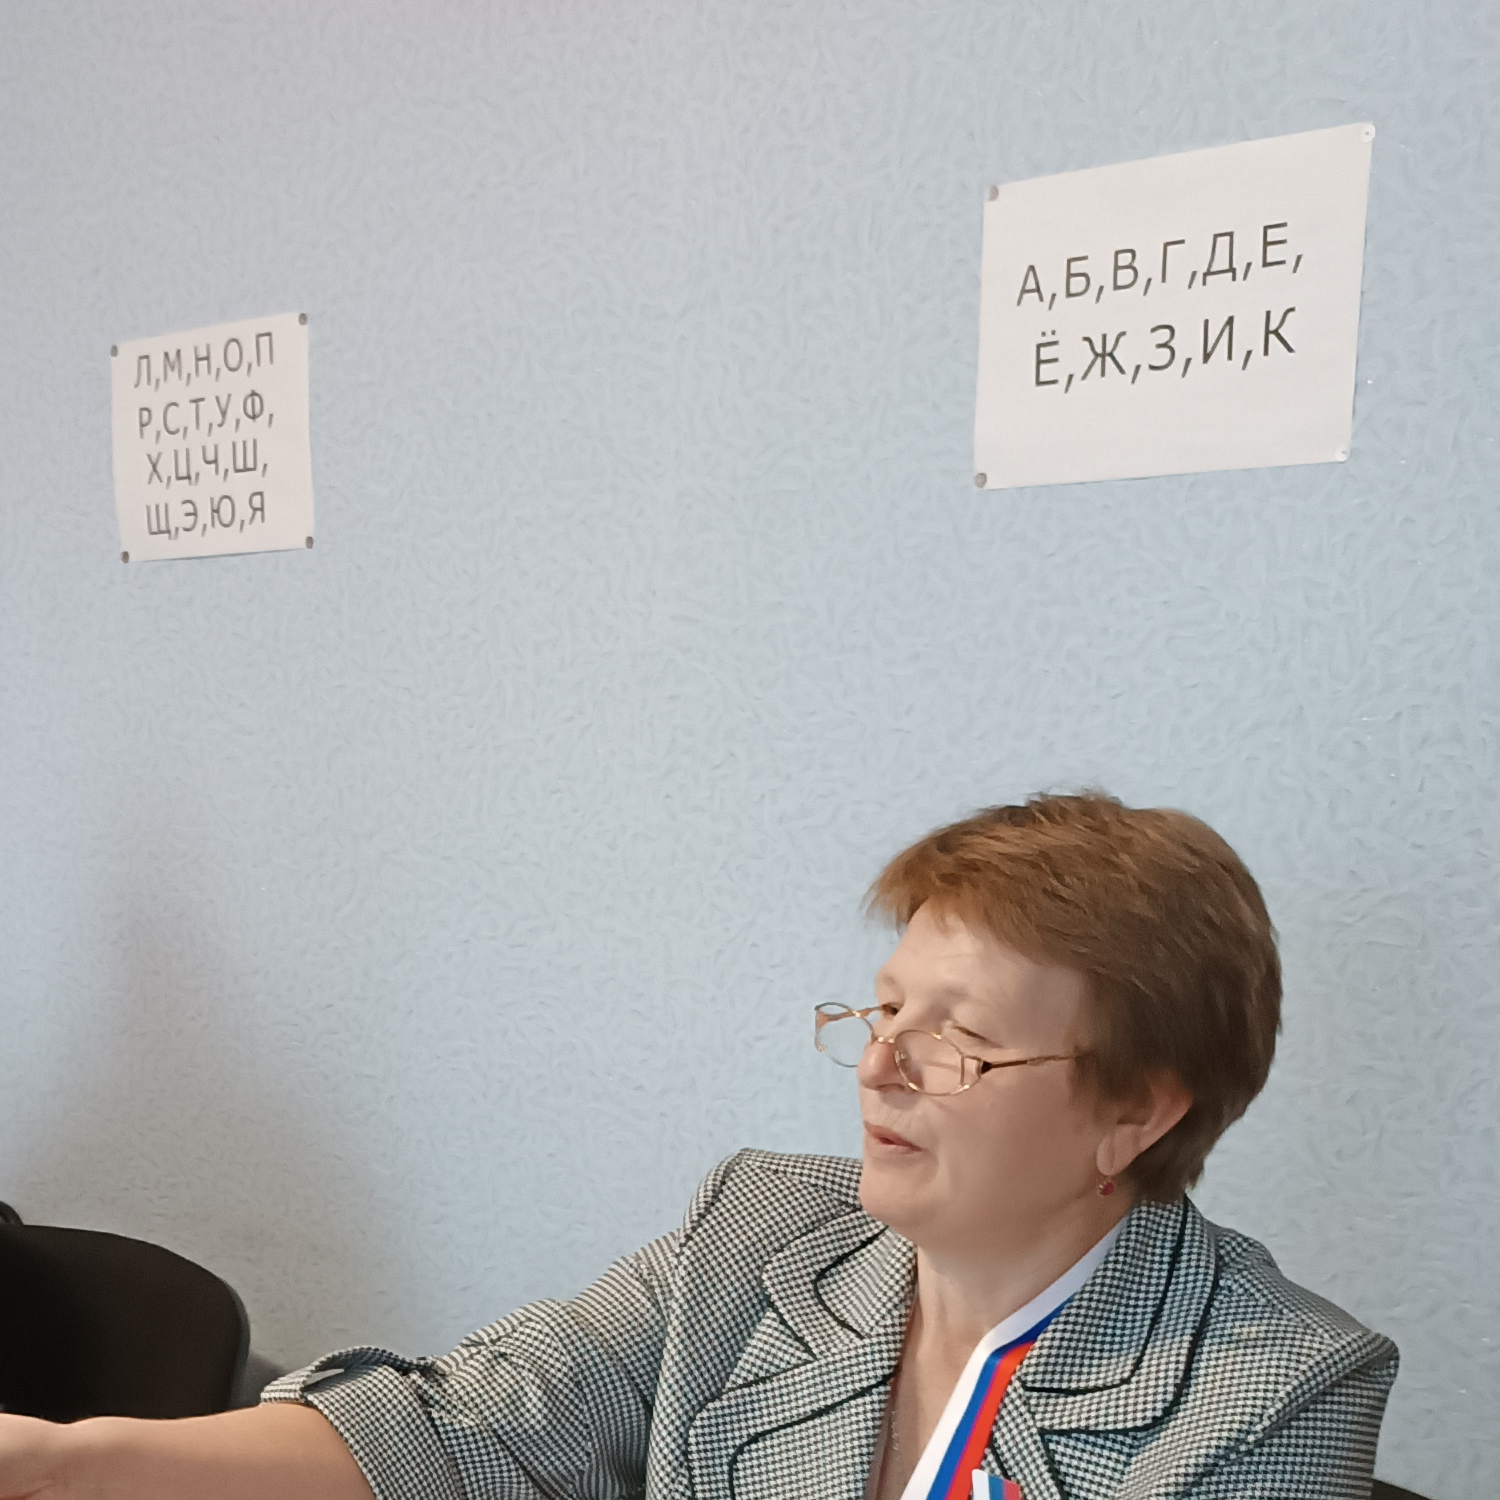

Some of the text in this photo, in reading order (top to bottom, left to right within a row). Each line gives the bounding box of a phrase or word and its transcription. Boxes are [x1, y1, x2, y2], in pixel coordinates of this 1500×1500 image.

[134, 332, 274, 392] Л,М,Н,О,П
[1034, 307, 1297, 394] Ё,Ж,З,И,К
[145, 491, 266, 540] Щ,Э,Ю,Я
